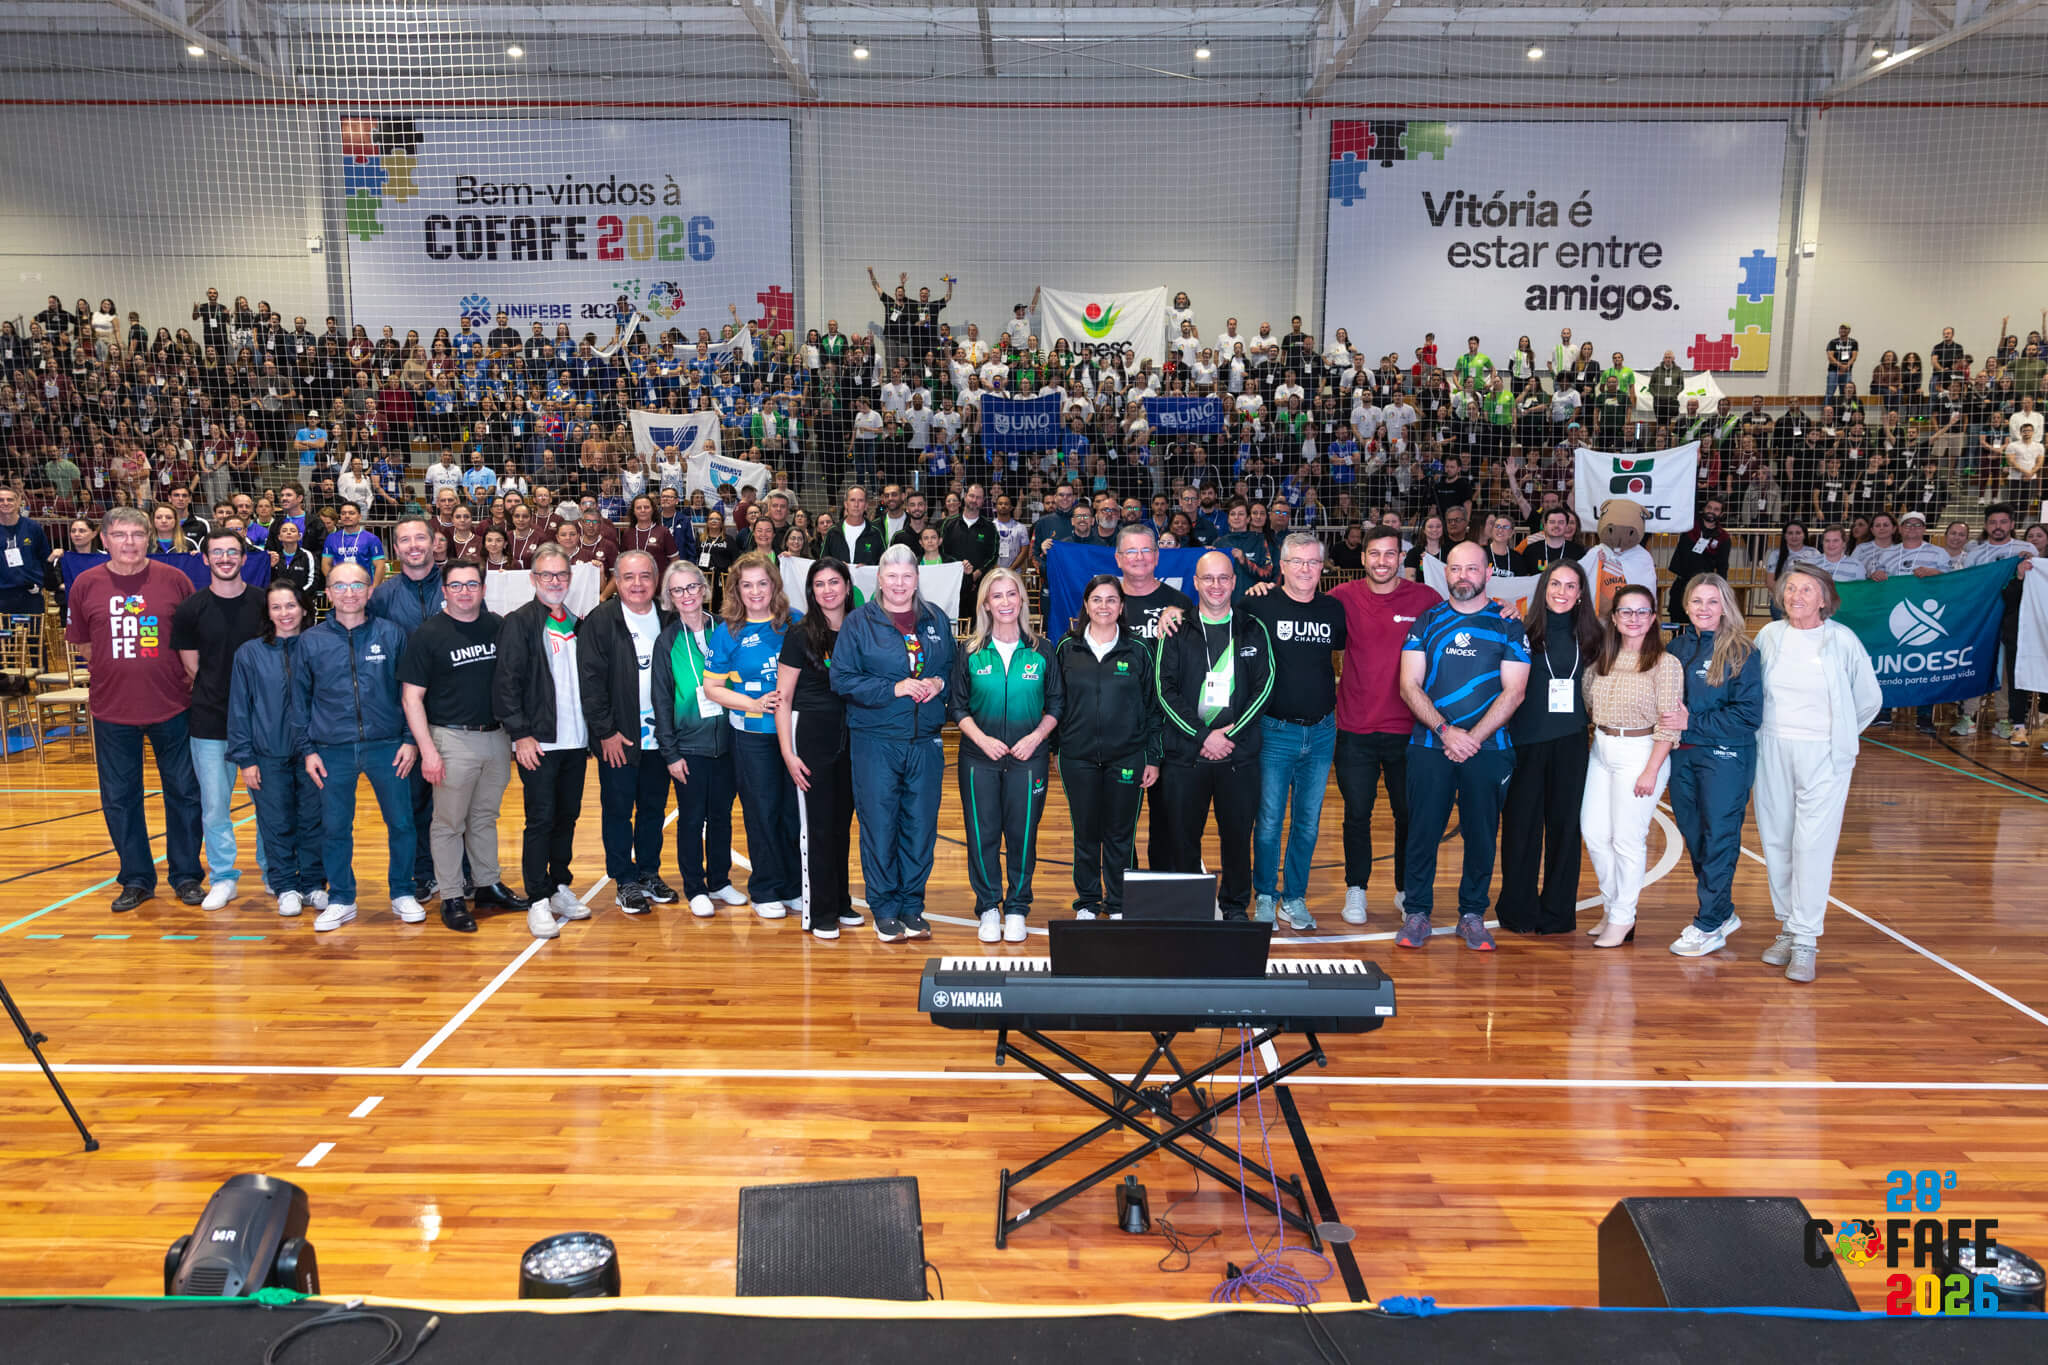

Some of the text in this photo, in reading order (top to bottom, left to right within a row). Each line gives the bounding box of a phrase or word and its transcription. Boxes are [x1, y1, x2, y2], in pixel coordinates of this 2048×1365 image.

[456, 174, 681, 206] Bem-vindos à
[1422, 190, 1593, 227] Vitória é
[425, 215, 715, 261] COFAFE 2026
[1447, 235, 1662, 268] estar entre
[1525, 275, 1680, 320] amigos.
[1011, 412, 1050, 430] UNO
[1177, 402, 1214, 425] UNO
[710, 461, 743, 476] UNIDAVI
[110, 615, 138, 637] FA
[139, 615, 159, 659] 2026
[1295, 621, 1331, 637] UNO
[112, 637, 137, 659] FE
[1445, 647, 1478, 657] UNOESC
[1872, 646, 1973, 675] UNOESC
[1905, 676, 1928, 687] parte
[1930, 674, 1940, 683] da
[1942, 673, 1956, 682] sua
[1958, 669, 1976, 678] vida
[950, 991, 1003, 1008] YAMAHA
